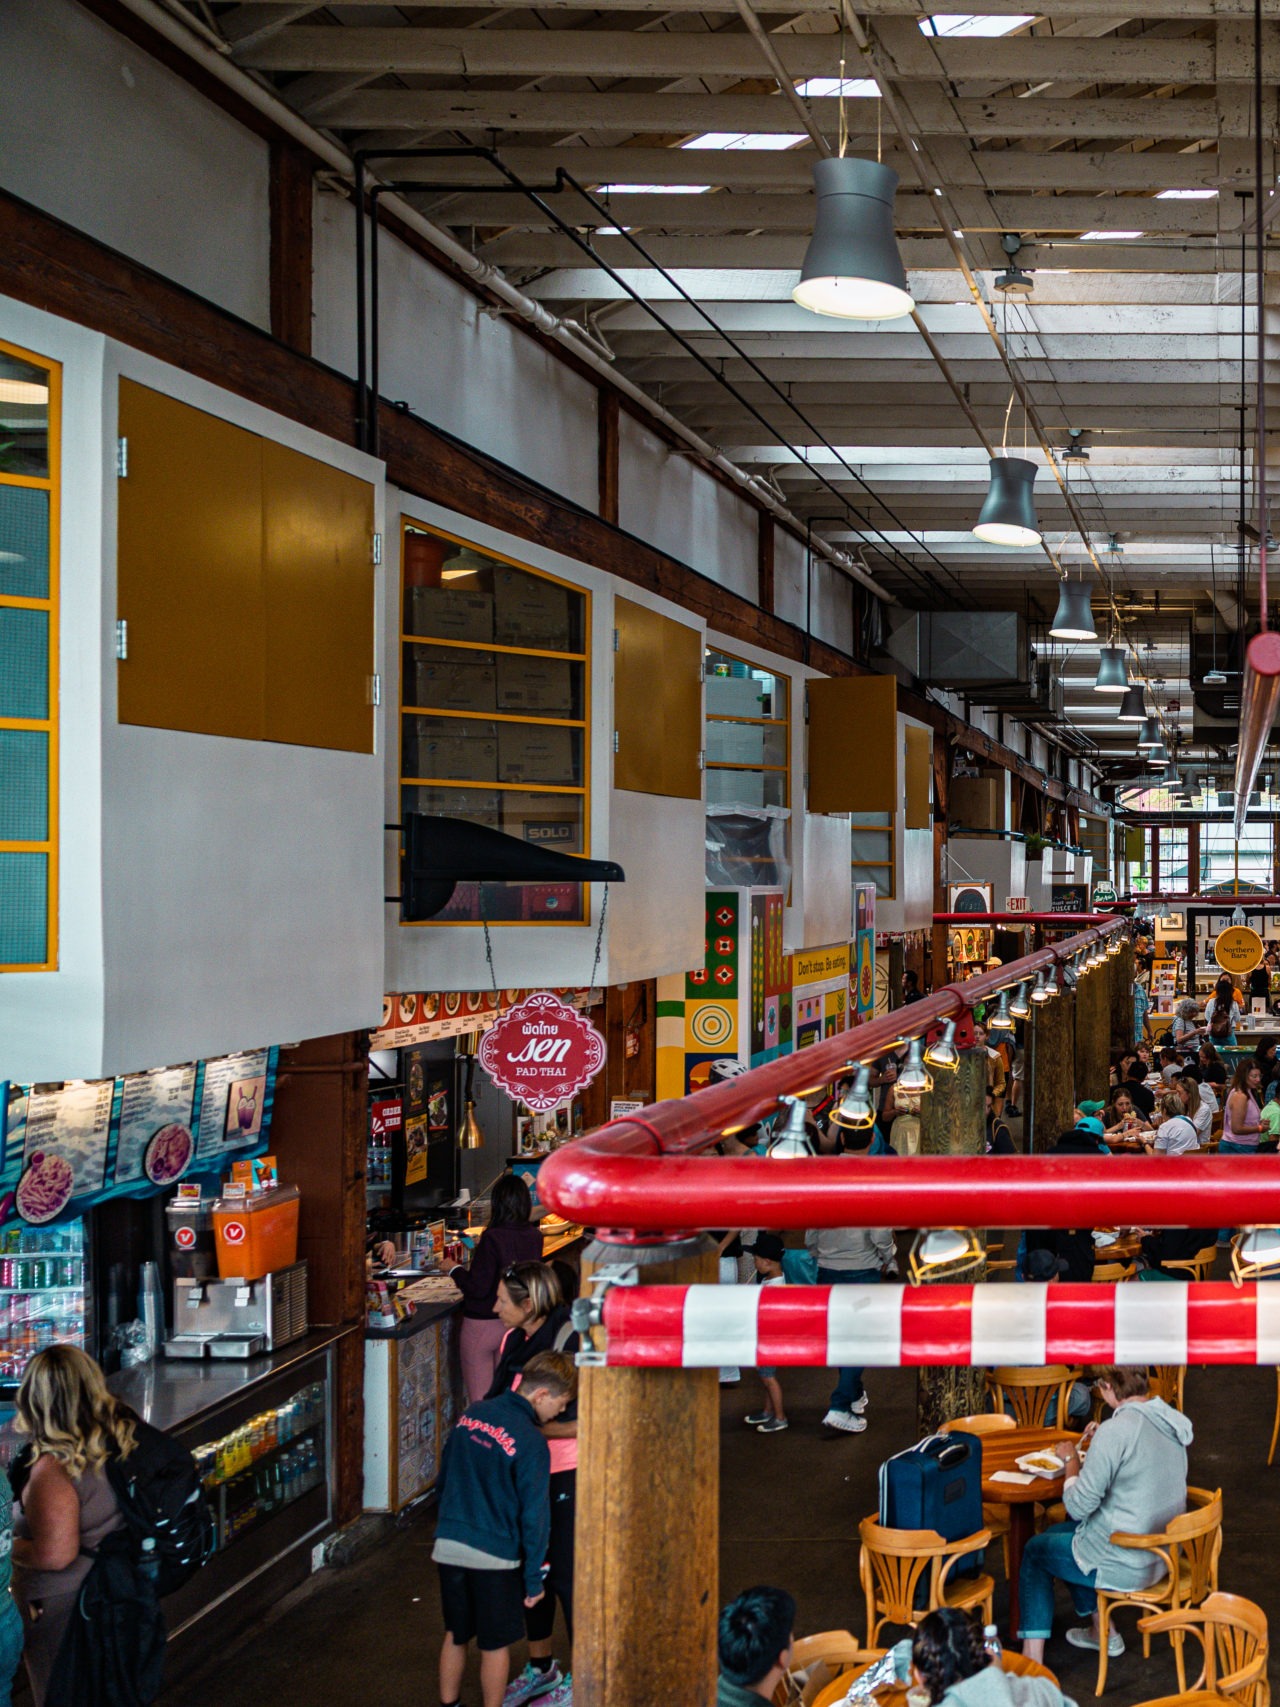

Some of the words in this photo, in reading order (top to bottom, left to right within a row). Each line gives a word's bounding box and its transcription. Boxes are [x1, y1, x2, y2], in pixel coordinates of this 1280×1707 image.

[527, 826, 569, 839] SOLO
[1010, 898, 1026, 910] EXIT
[798, 960, 812, 976] Don't
[506, 1038, 572, 1062] sen
[516, 1067, 537, 1076] PAD
[539, 1067, 567, 1076] THAI
